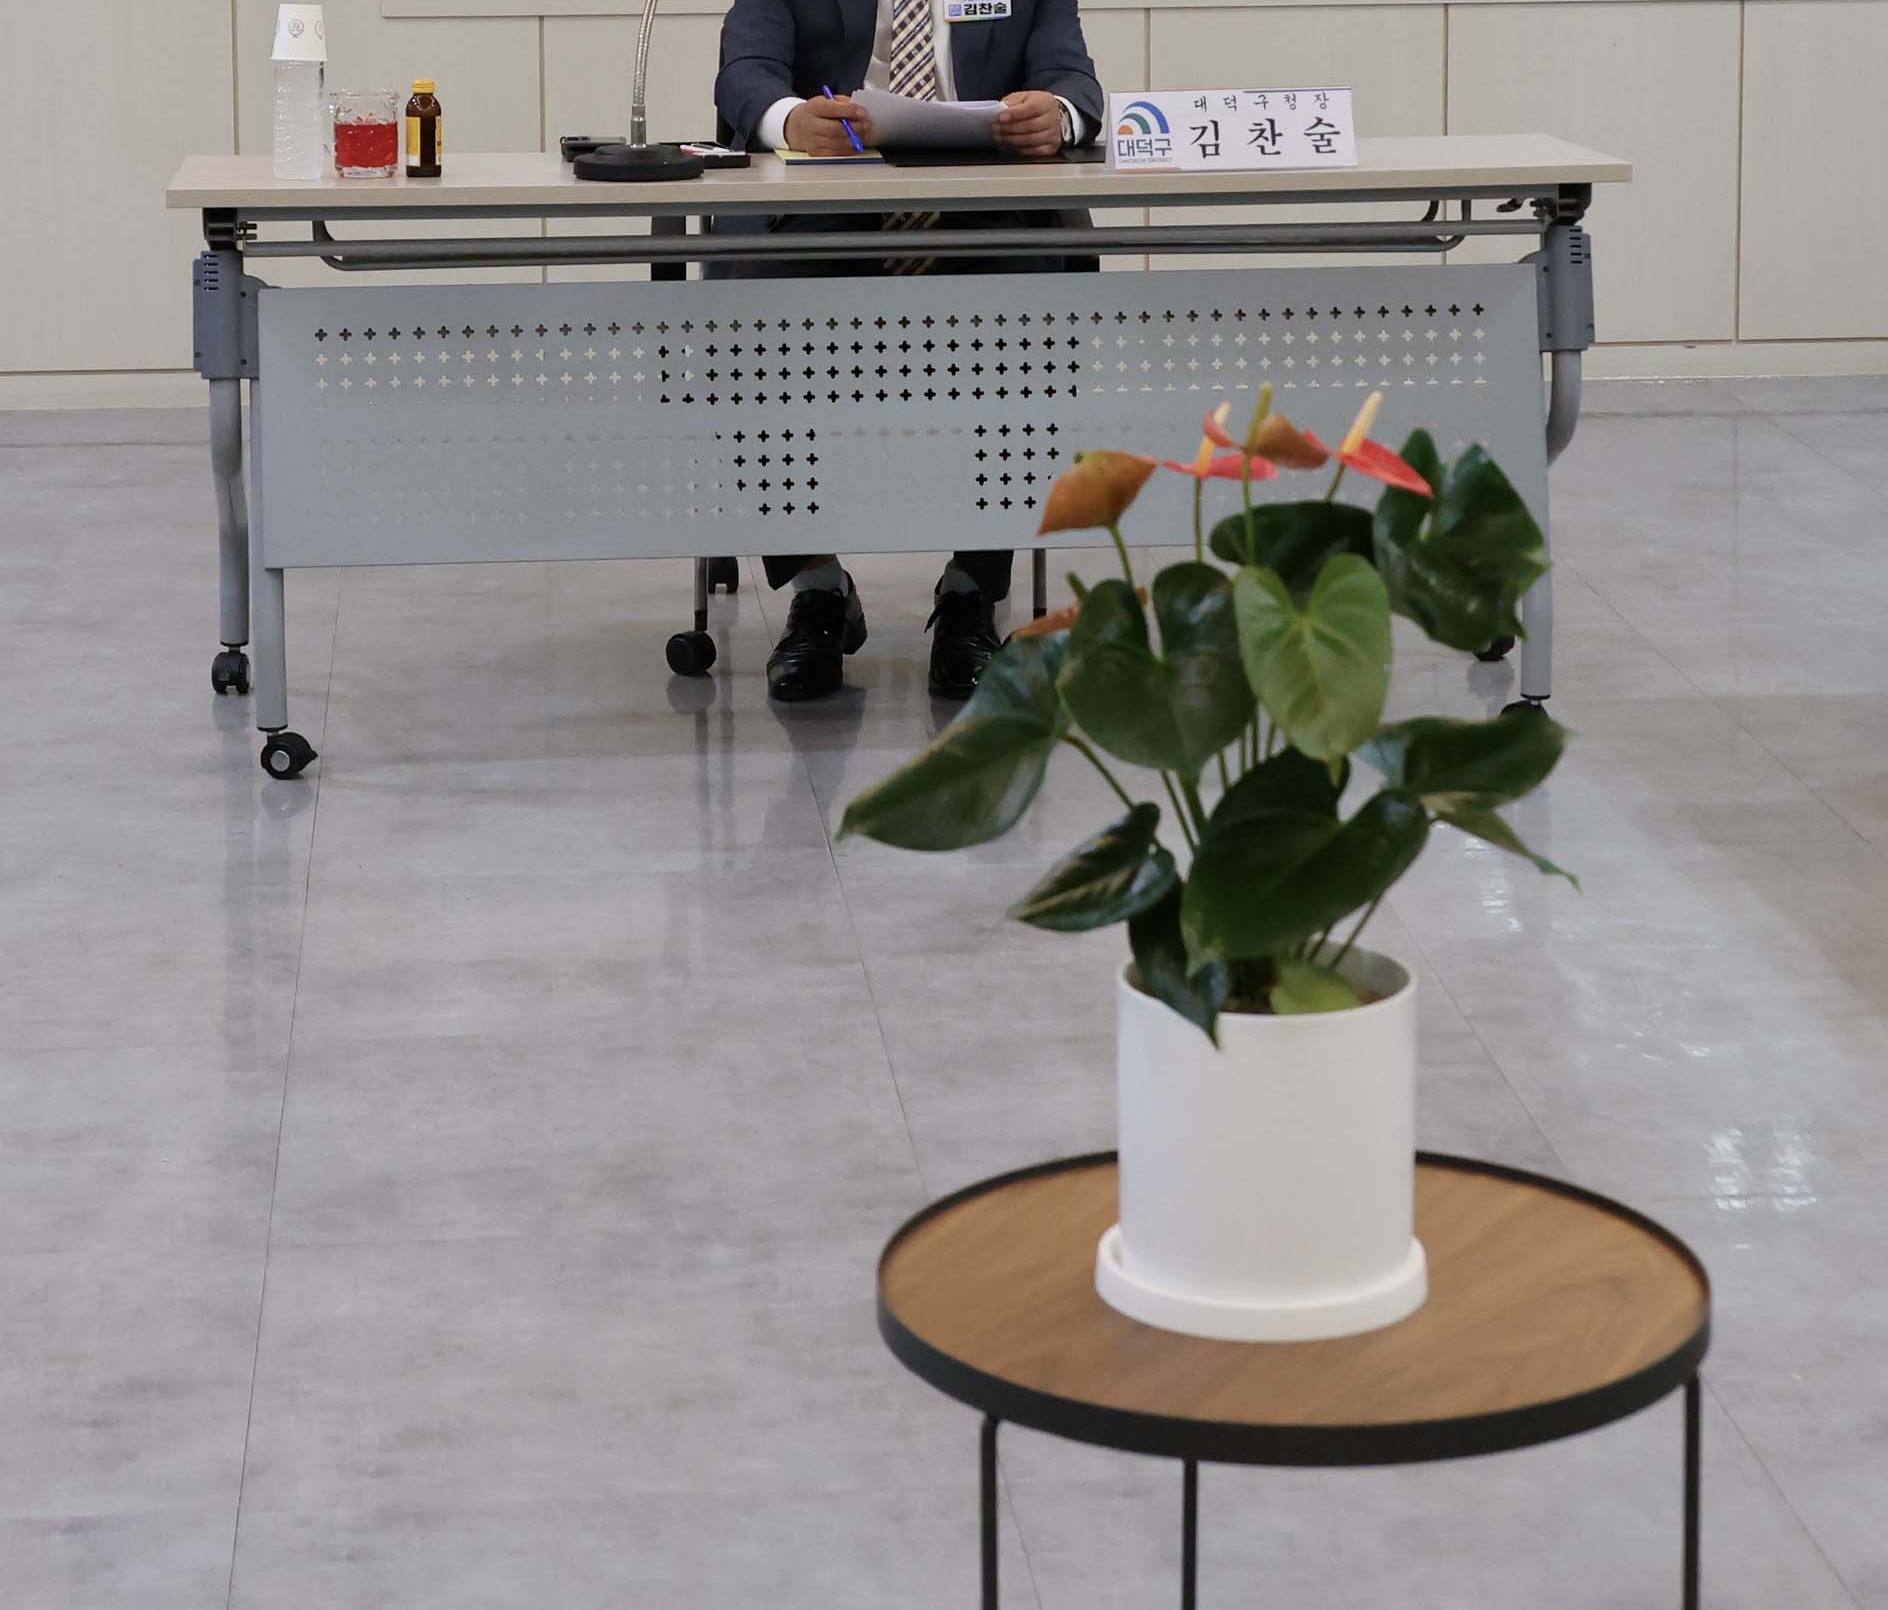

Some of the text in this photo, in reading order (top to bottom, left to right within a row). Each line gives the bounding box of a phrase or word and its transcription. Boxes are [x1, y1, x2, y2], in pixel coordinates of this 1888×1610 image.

[963, 2, 1007, 16] 김찬술
[1192, 92, 1330, 113] 대덕구청장
[1117, 137, 1172, 158] 대덕구
[1188, 115, 1342, 159] 김찬술
